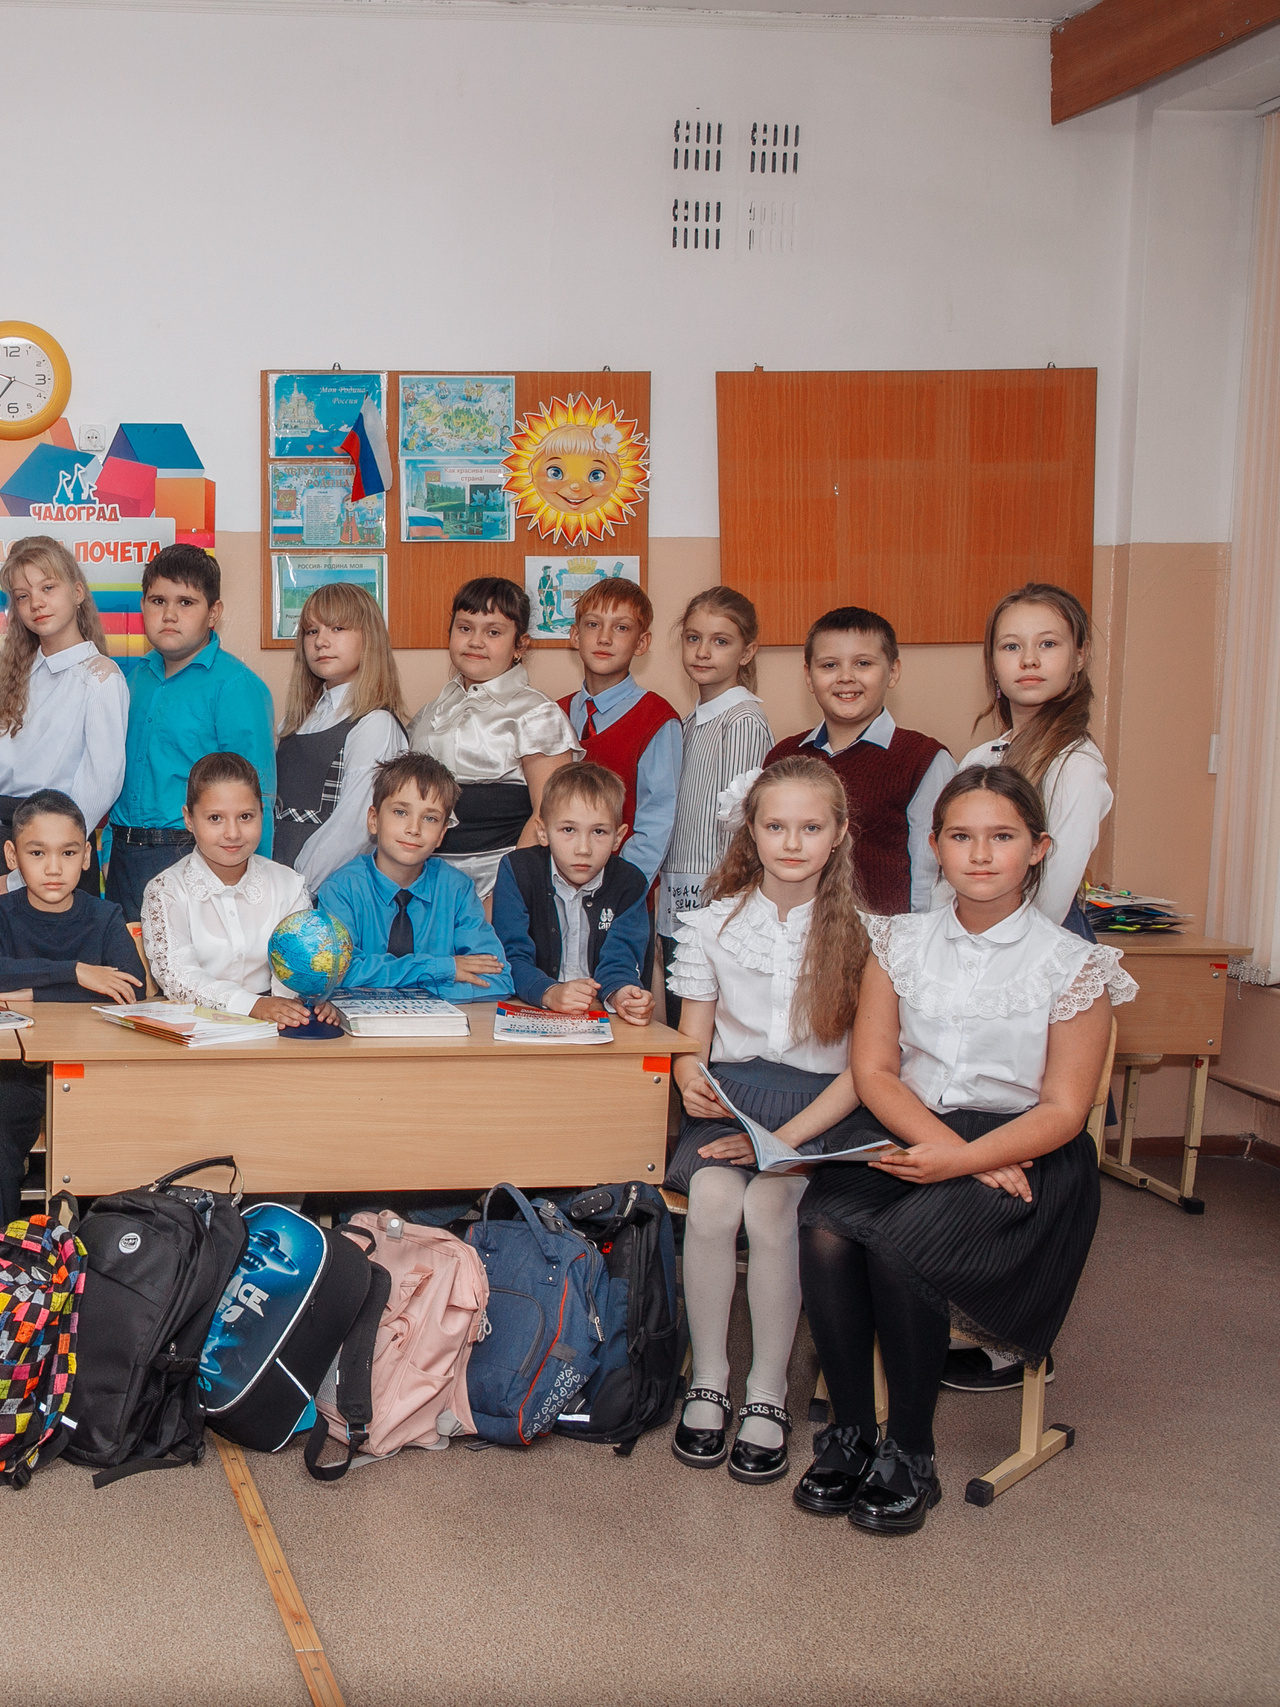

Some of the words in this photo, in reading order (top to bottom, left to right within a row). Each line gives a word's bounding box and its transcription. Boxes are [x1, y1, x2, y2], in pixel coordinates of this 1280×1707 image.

[2, 346, 21, 358] 12
[35, 374, 47, 386] 3
[332, 397, 358, 405] Россия
[7, 402, 20, 414] 6
[284, 467, 309, 476] ЧЕГО
[312, 467, 355, 476] НАЧИНА
[306, 479, 351, 488] РОДИНА
[31, 504, 120, 522] ЧАДОГРАД
[75, 540, 162, 564] ПОЧЕТА
[225, 1275, 269, 1317] ACE
[216, 1295, 244, 1323] FO
[751, 1404, 770, 1415] bts
